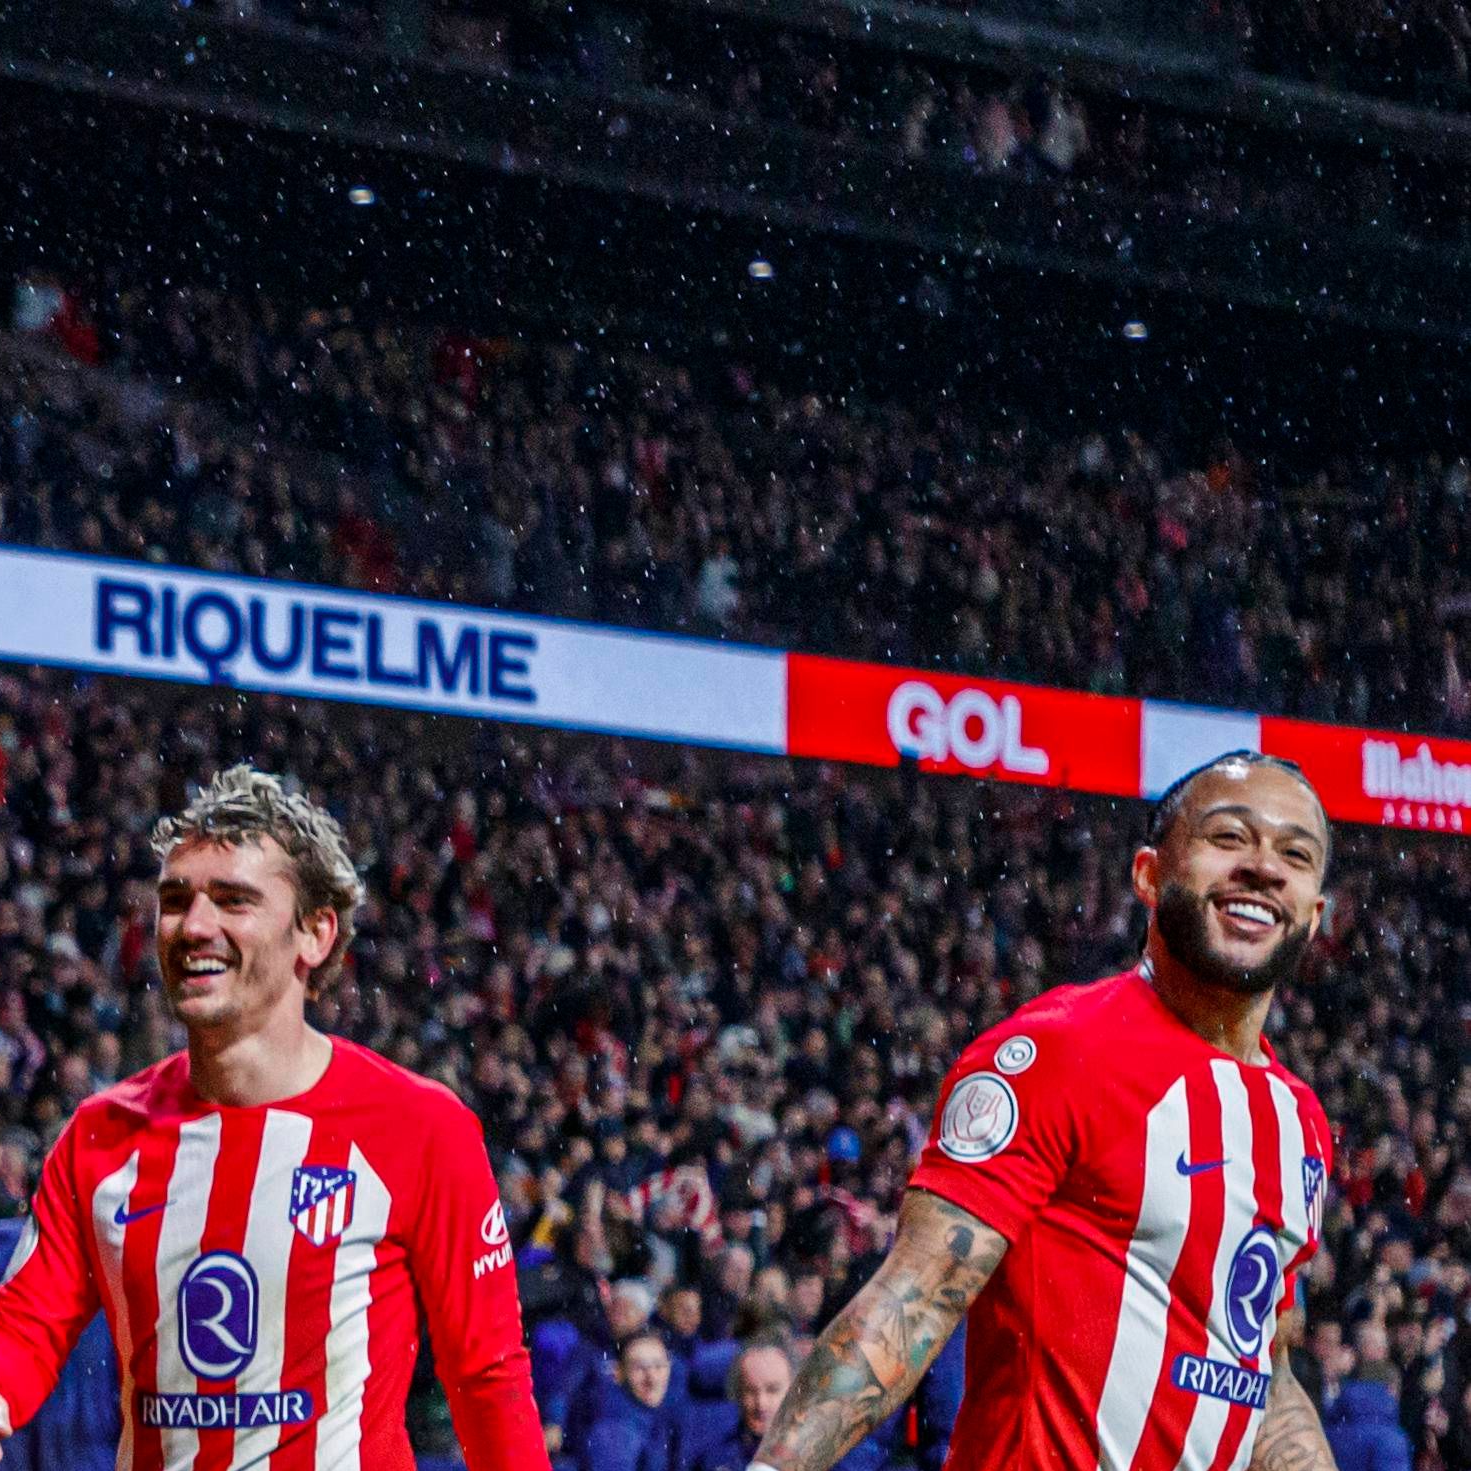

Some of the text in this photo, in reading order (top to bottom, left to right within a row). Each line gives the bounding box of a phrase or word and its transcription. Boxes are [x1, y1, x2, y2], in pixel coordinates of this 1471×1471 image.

[95, 578, 538, 704] RIQUELME
[887, 680, 1049, 775] GOL
[143, 1392, 305, 1426] RIYADH AIR
[1179, 1356, 1264, 1405] RIYADH
